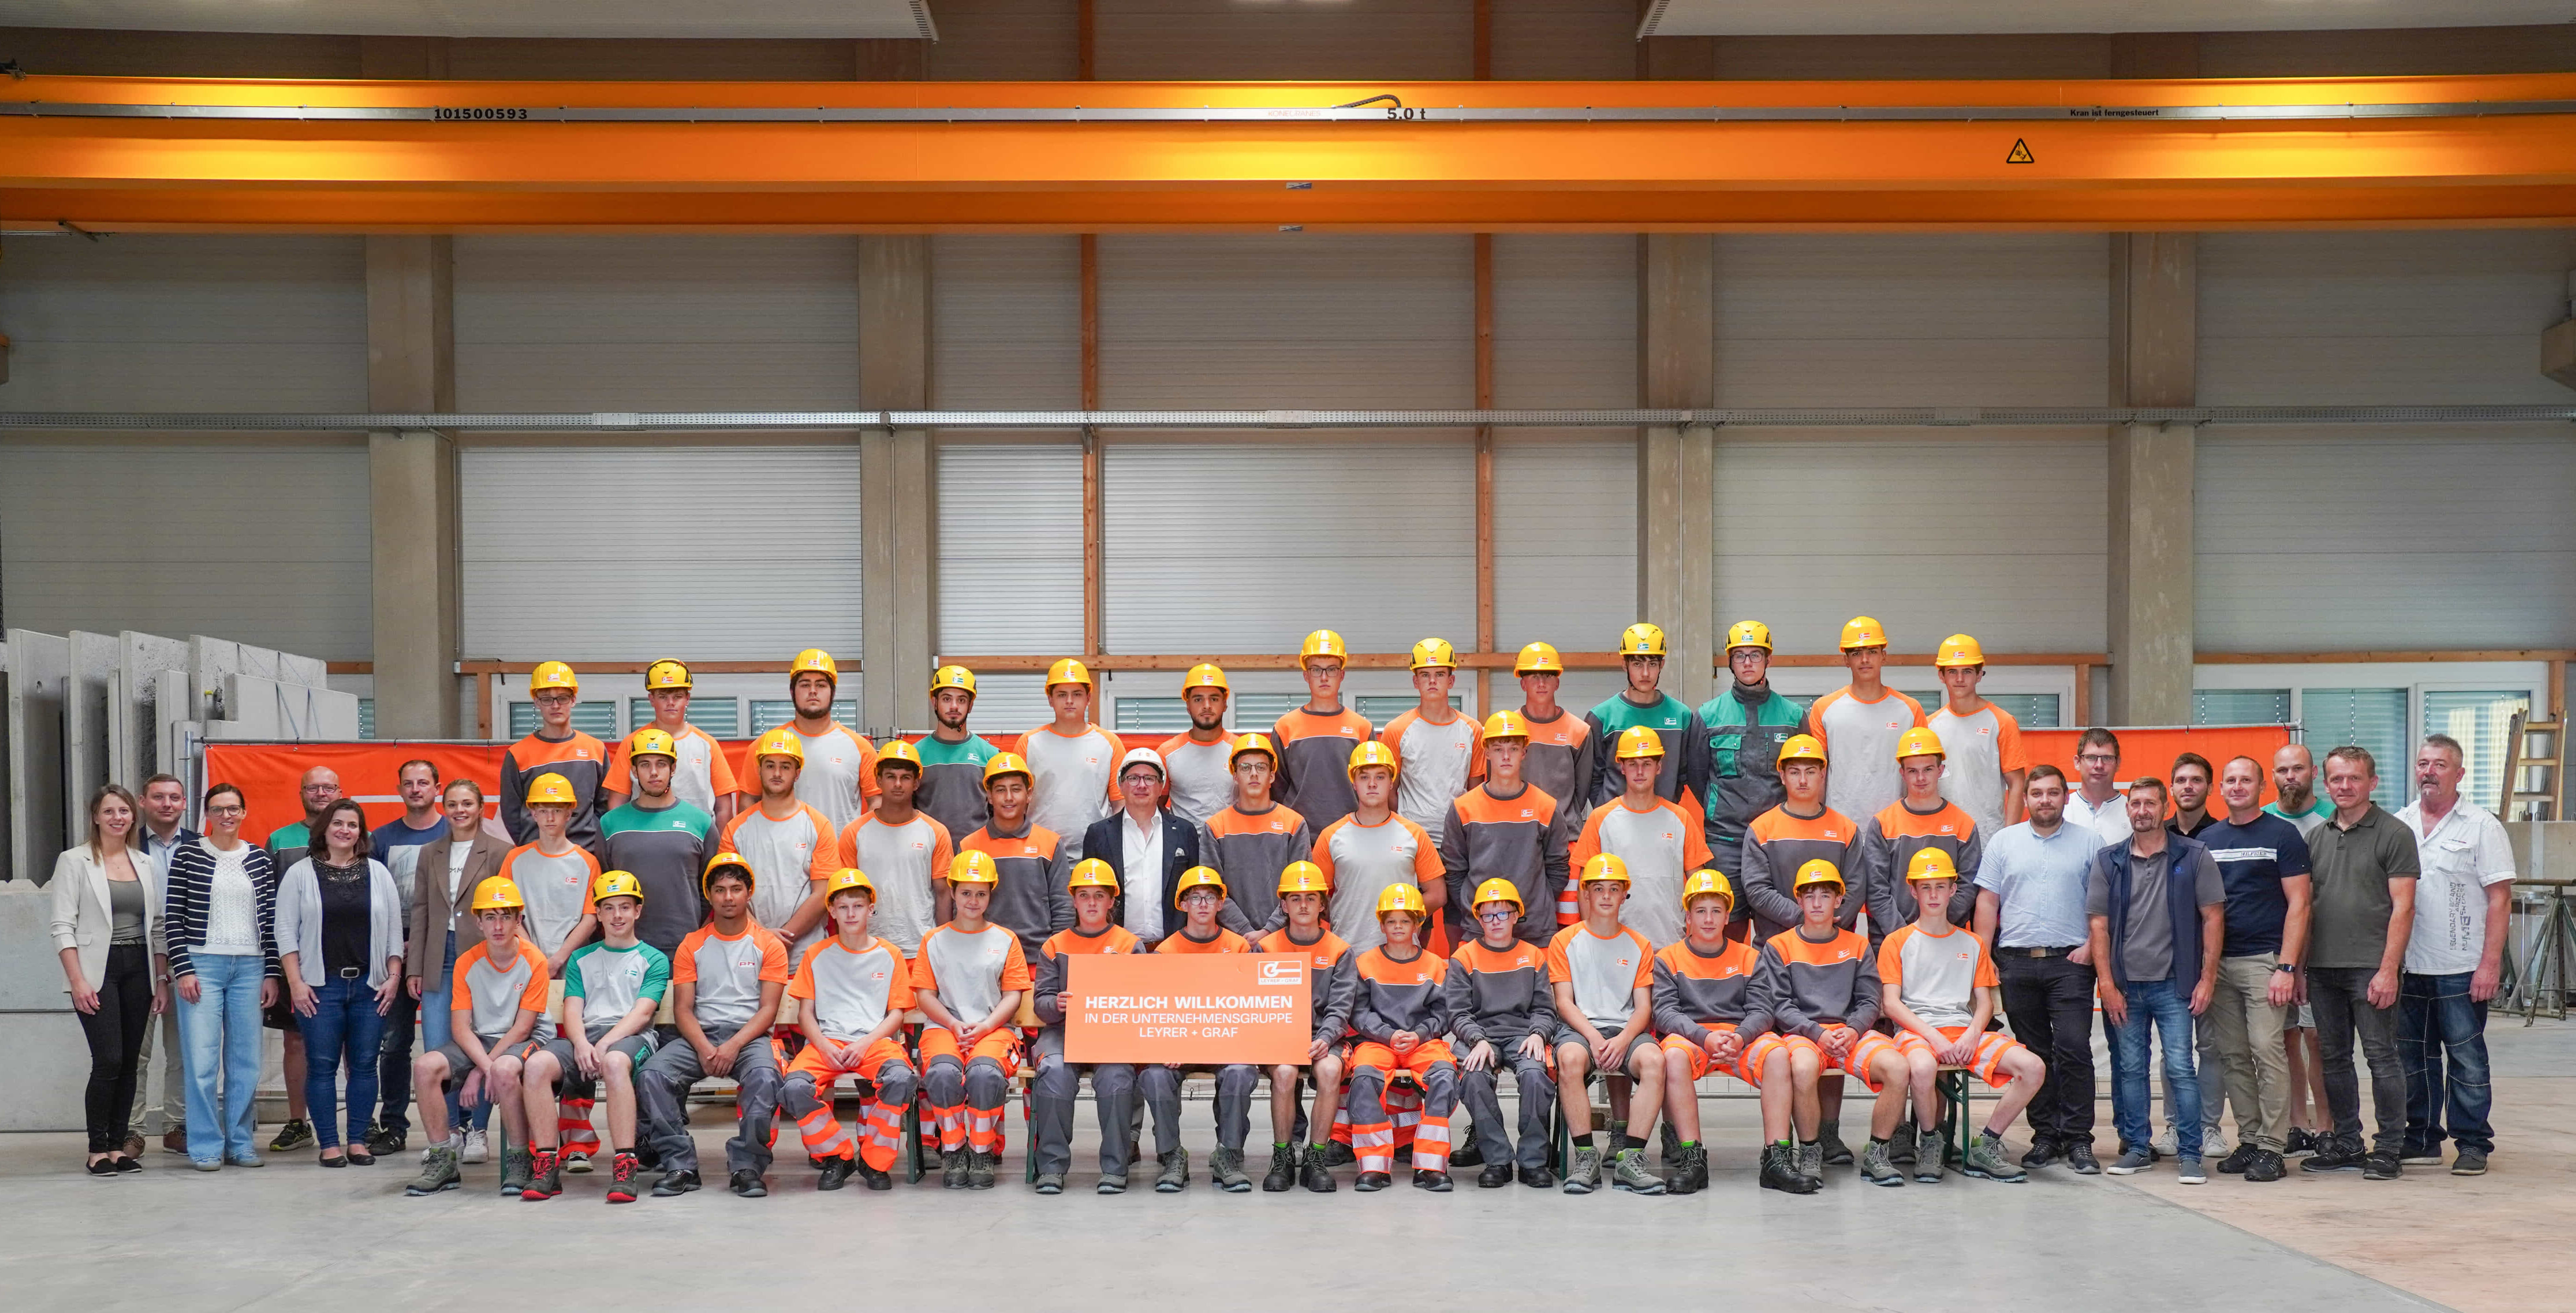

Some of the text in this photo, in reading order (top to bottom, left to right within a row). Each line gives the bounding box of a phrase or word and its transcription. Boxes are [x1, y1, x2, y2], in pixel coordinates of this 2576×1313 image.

[434, 108, 528, 119] 101500593
[1387, 108, 1426, 120] 5.0 t
[2104, 109, 2159, 118] ferngesteuert
[1086, 996, 1293, 1009] HERZLICH WILLKOMMEN
[1085, 1013, 1293, 1024] IN DER UNTERNEHMENSGRUPPE
[1140, 1027, 1187, 1038] LEYRER
[1202, 1027, 1238, 1038] GRAF
